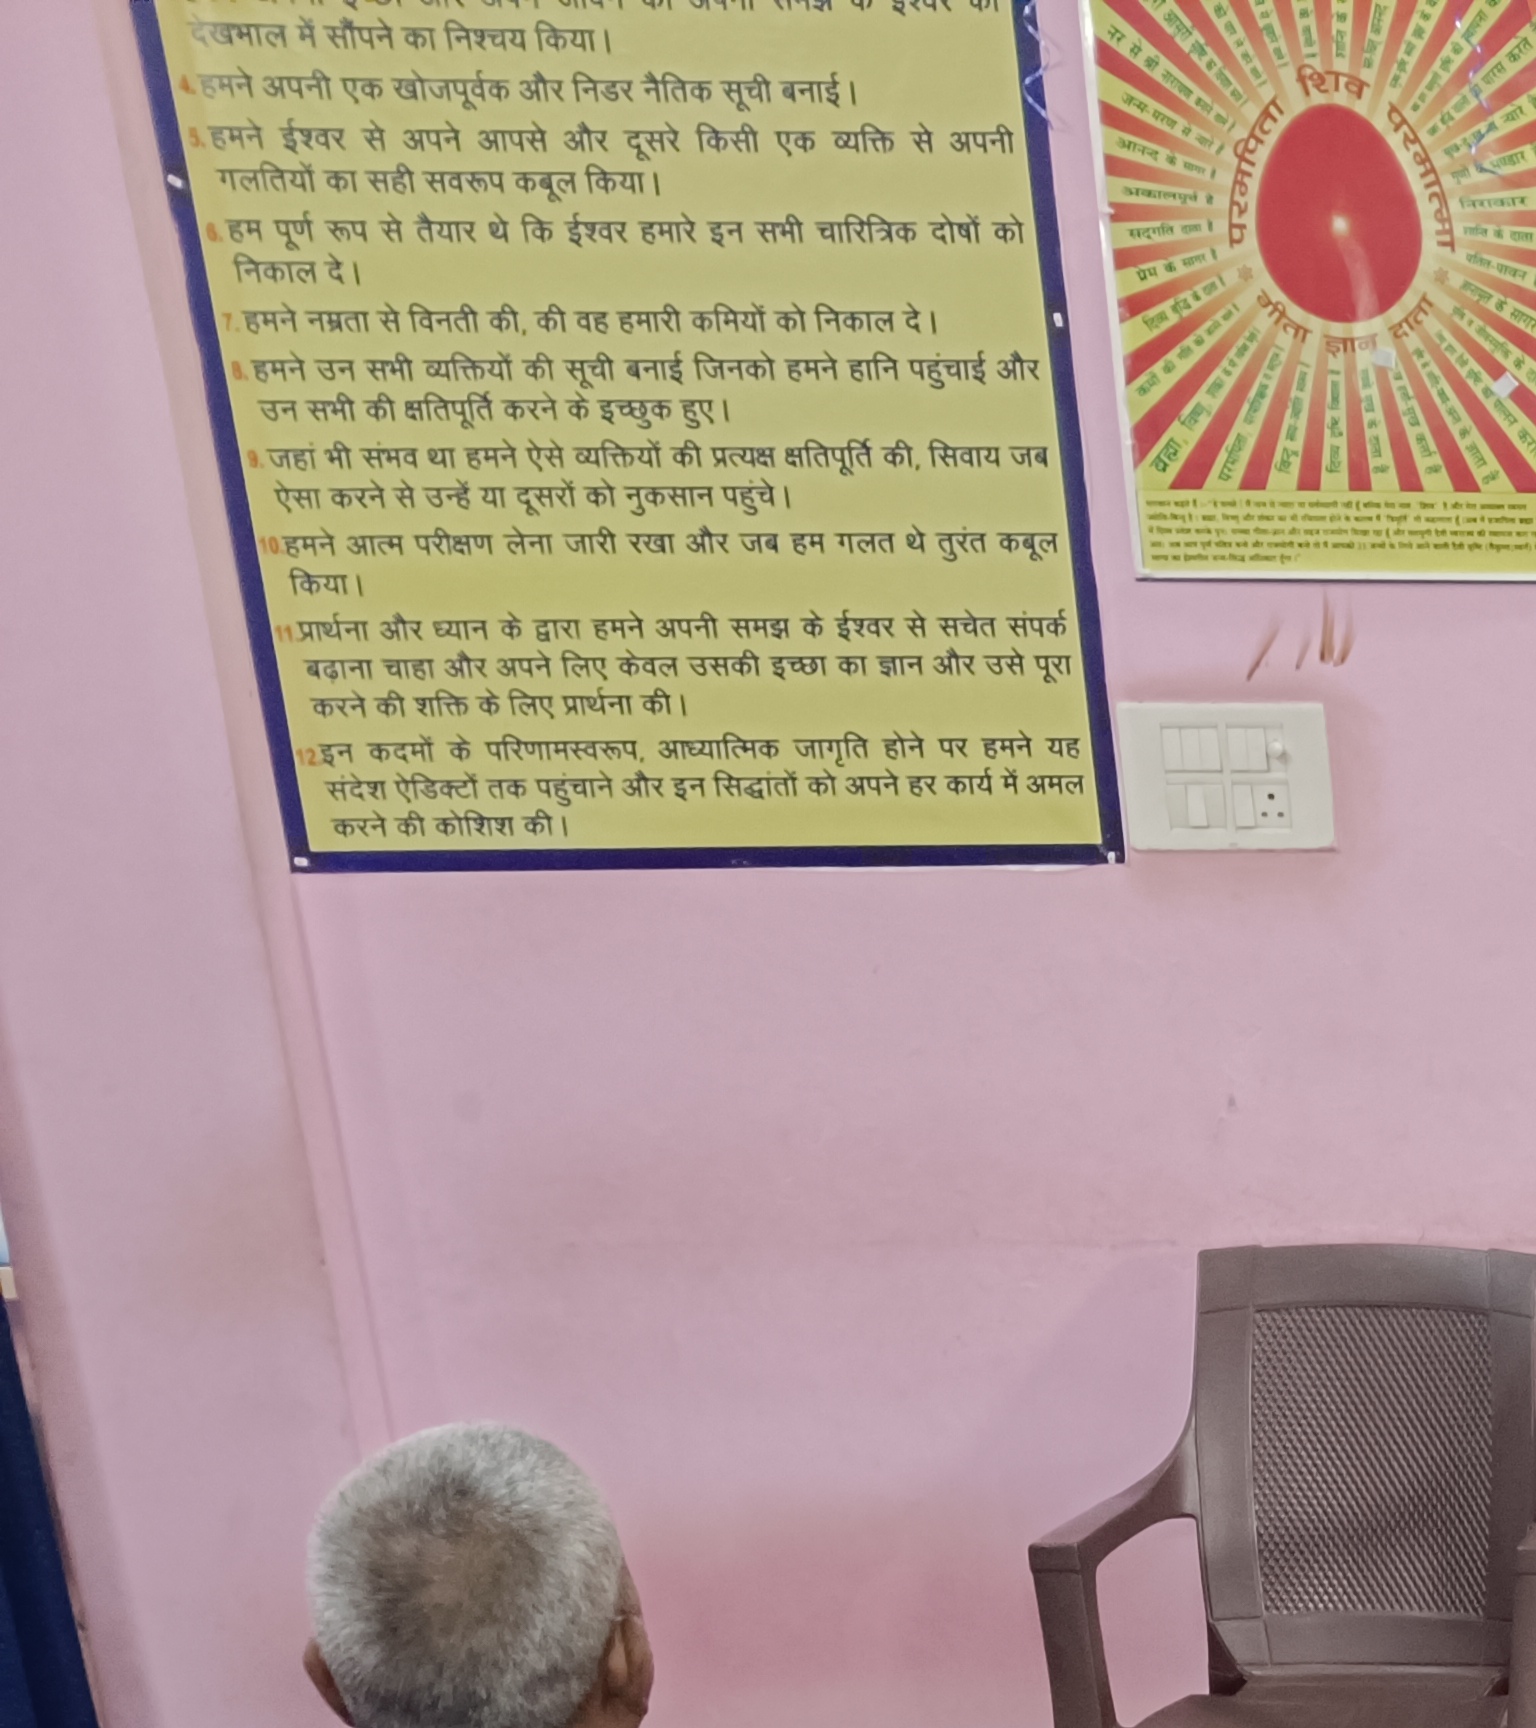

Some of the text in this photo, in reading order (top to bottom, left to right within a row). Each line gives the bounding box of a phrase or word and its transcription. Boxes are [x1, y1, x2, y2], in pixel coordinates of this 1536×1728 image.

[1297, 63, 1370, 100] शिव
[225, 219, 262, 243] हम
[273, 210, 313, 251] पूर्ण
[324, 220, 367, 242] रूप
[379, 212, 402, 243] से
[414, 212, 476, 243] तैयार
[488, 212, 509, 243] थे
[521, 213, 553, 243] कि
[564, 212, 627, 248] ईश्वर
[638, 212, 696, 245] हमारे
[707, 222, 743, 247] इन
[754, 214, 803, 243] सभी
[928, 213, 980, 245] दोषों
[992, 213, 1024, 244] को
[1257, 288, 1312, 343] गीता
[1389, 292, 1434, 341] दाता
[303, 647, 1071, 683] बढ़ाना चाहा और अपने लिए केवल उसकी इच्छा का ज्ञान और उसे पूरा
